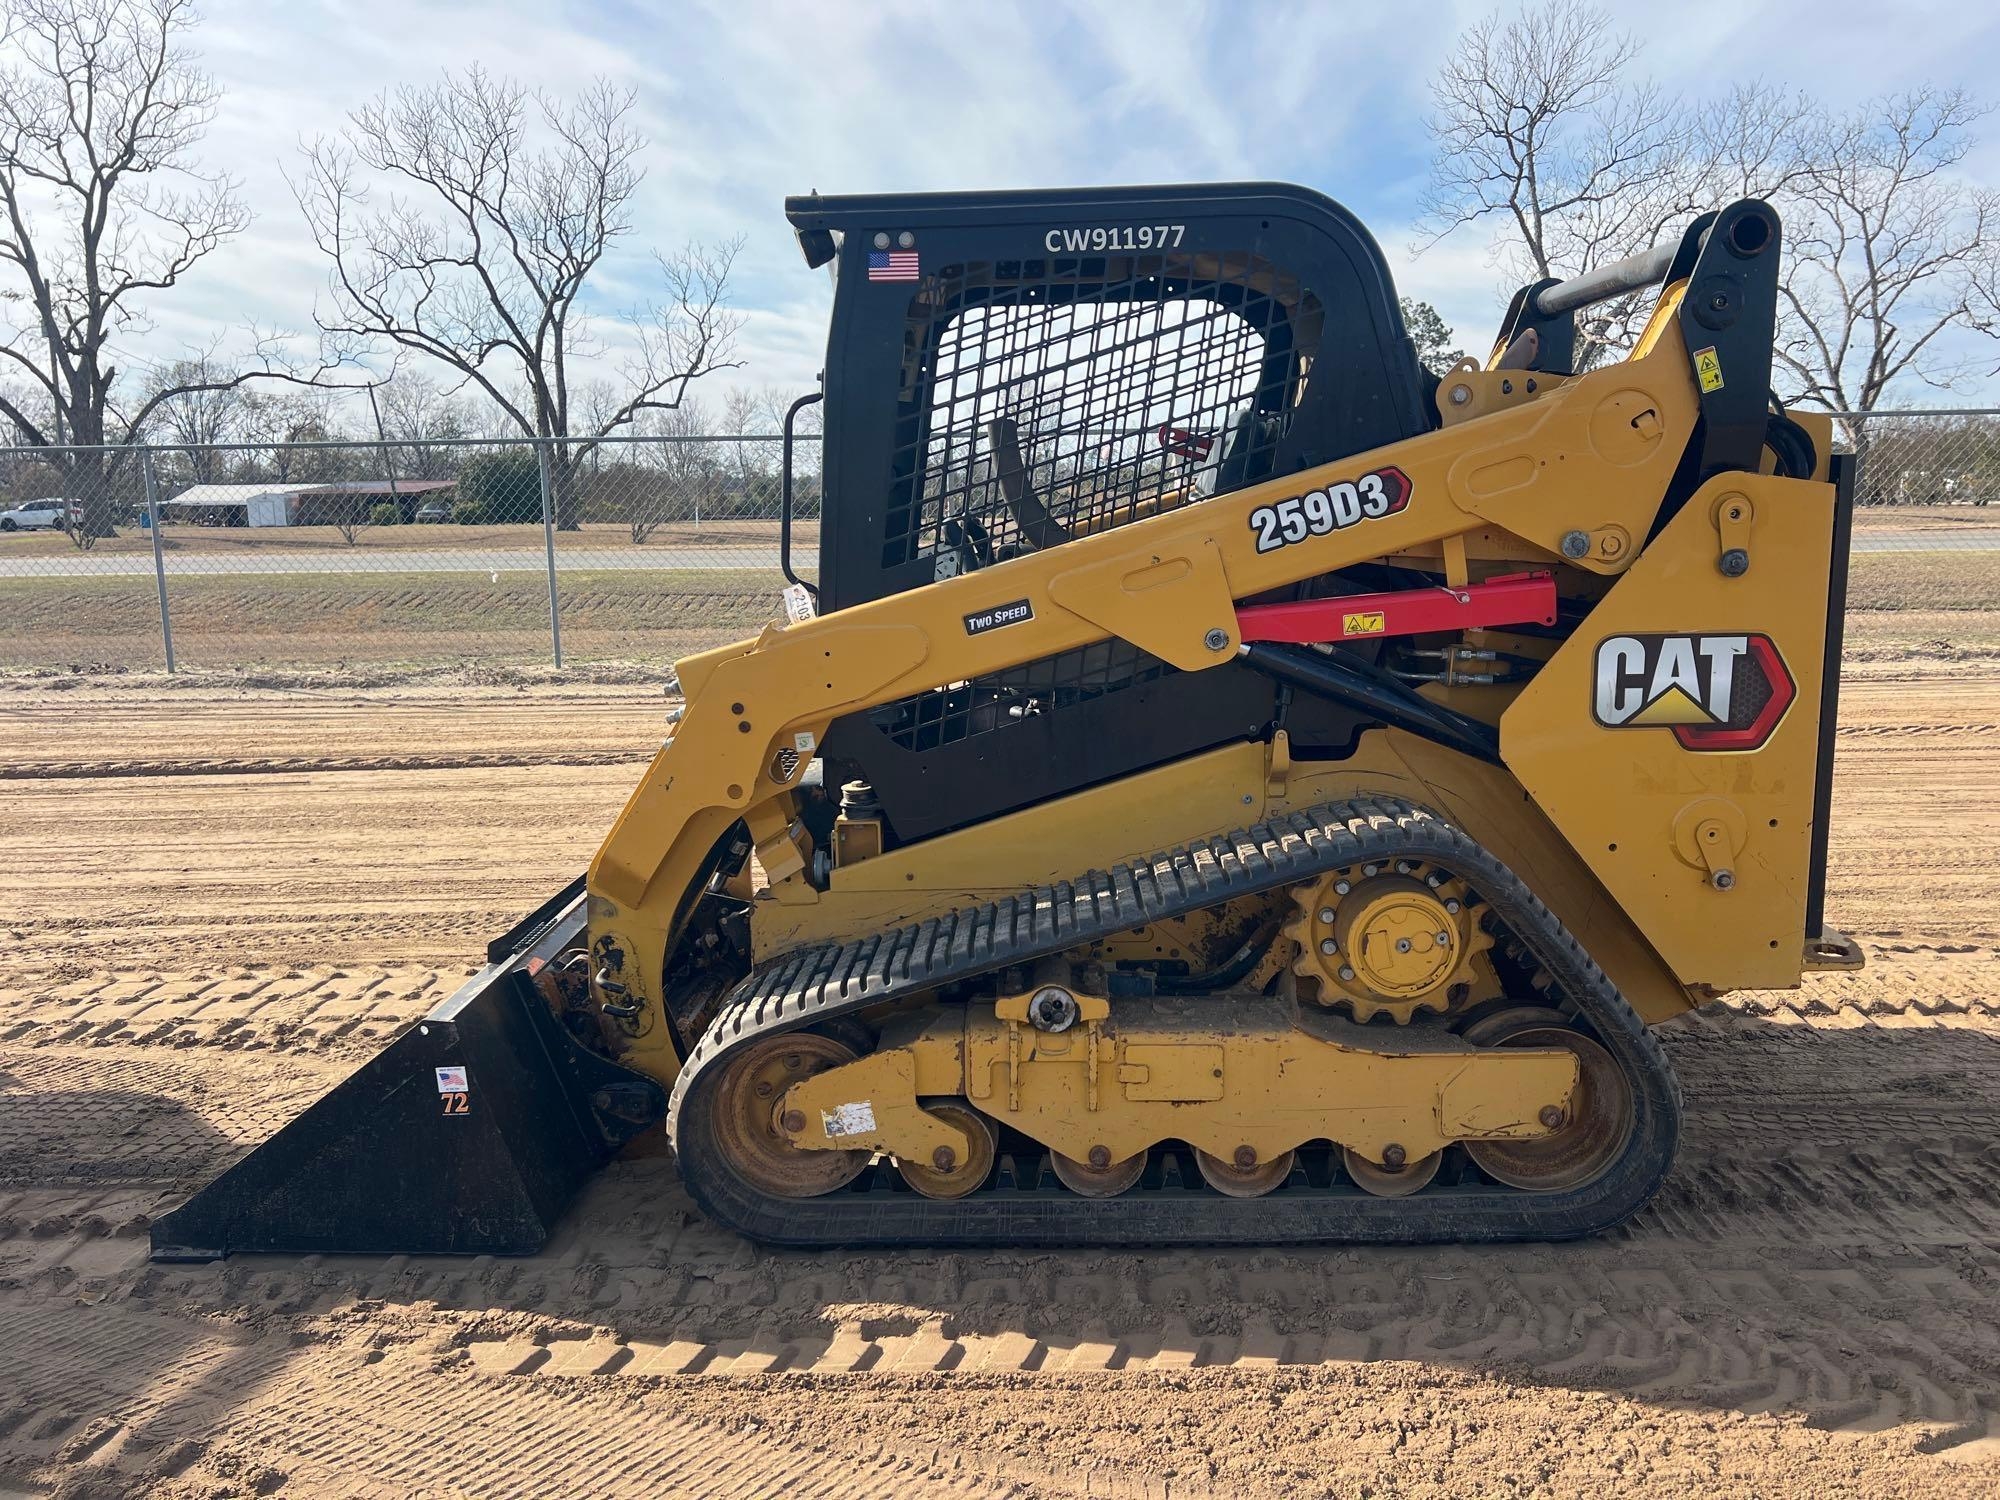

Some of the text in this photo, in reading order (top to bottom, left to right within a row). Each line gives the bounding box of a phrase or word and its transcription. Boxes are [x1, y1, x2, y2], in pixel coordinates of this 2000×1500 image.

[1045, 225, 1186, 252] CW911977
[1251, 474, 1389, 551] 259D3
[1596, 636, 1748, 725] CAT
[441, 1092, 469, 1113] 72
